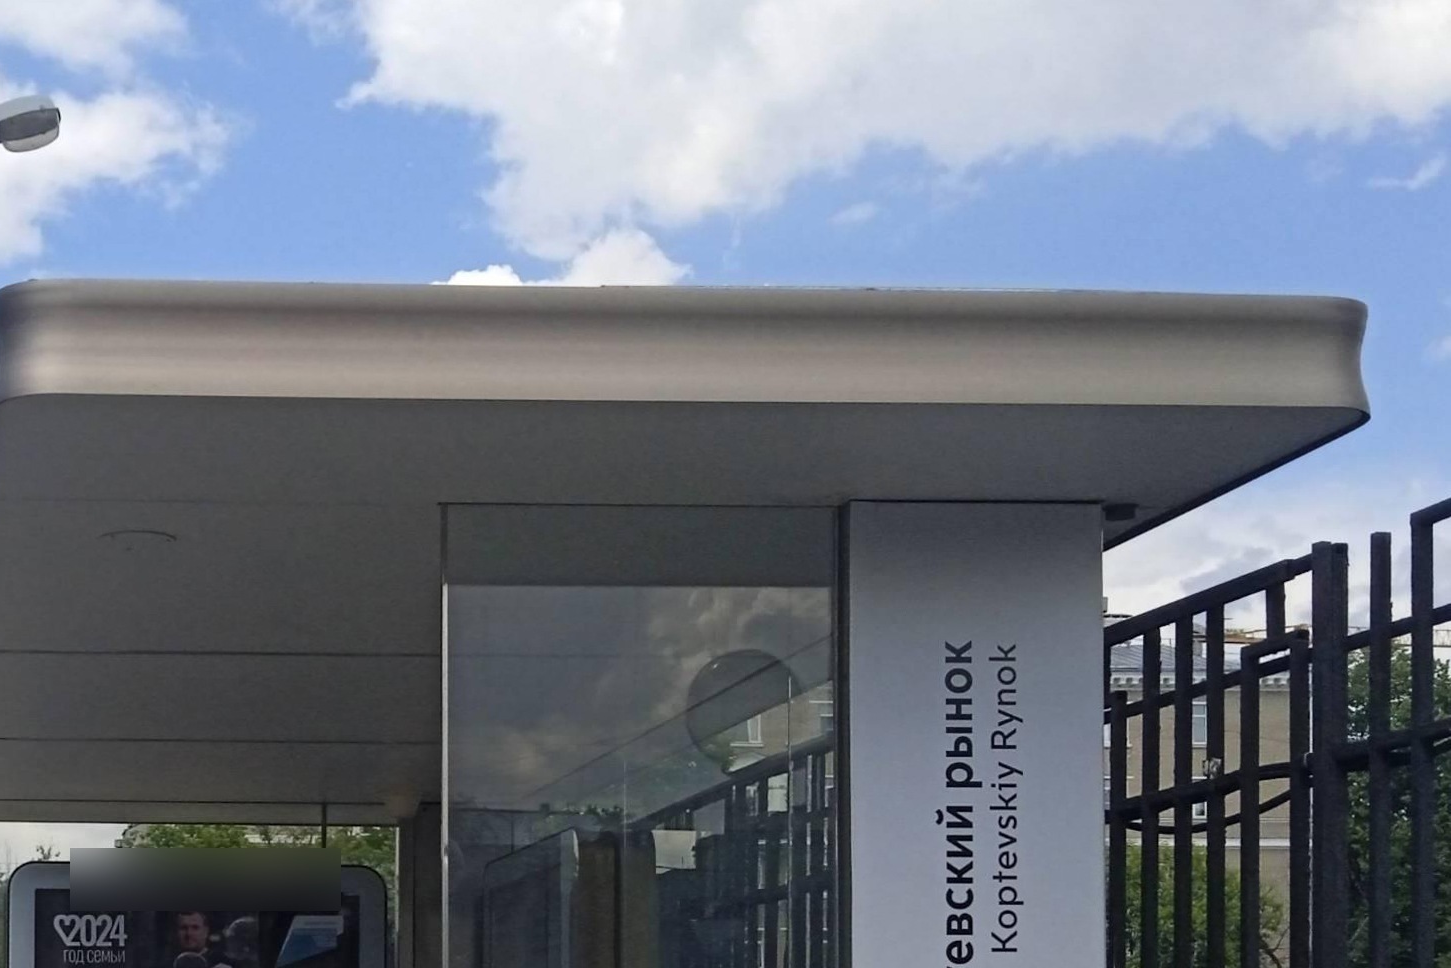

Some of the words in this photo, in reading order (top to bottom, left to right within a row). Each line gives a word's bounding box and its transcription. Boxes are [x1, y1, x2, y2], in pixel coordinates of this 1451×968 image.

[945, 640, 982, 788] рынок
[988, 643, 1023, 750] Rynok
[989, 761, 1023, 953] Koptevskiy
[59, 914, 128, 947] 2024
